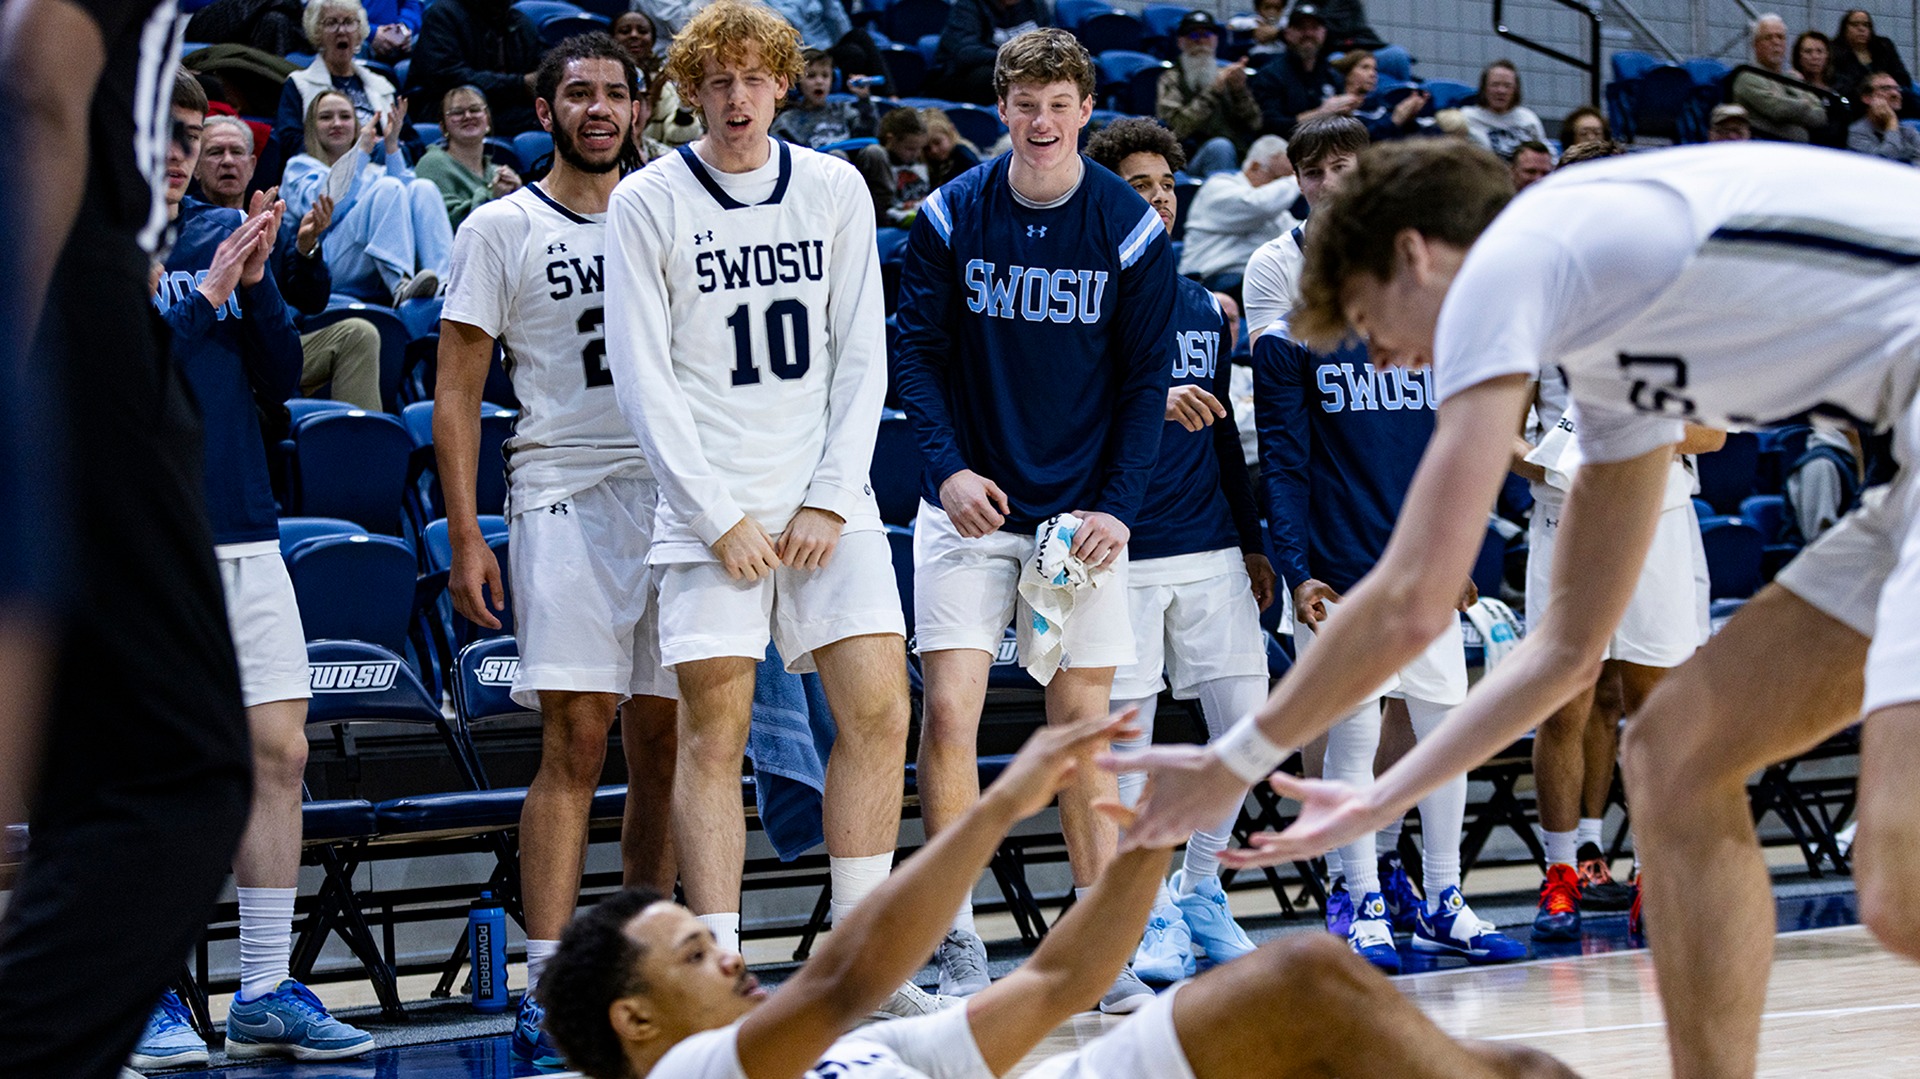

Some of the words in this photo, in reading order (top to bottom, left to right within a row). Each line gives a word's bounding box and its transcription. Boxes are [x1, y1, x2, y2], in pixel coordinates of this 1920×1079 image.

[695, 240, 824, 293] SWOSU
[965, 258, 1109, 324] SWOSU
[725, 297, 812, 388] 10
[478, 925, 491, 996] POWERADE
